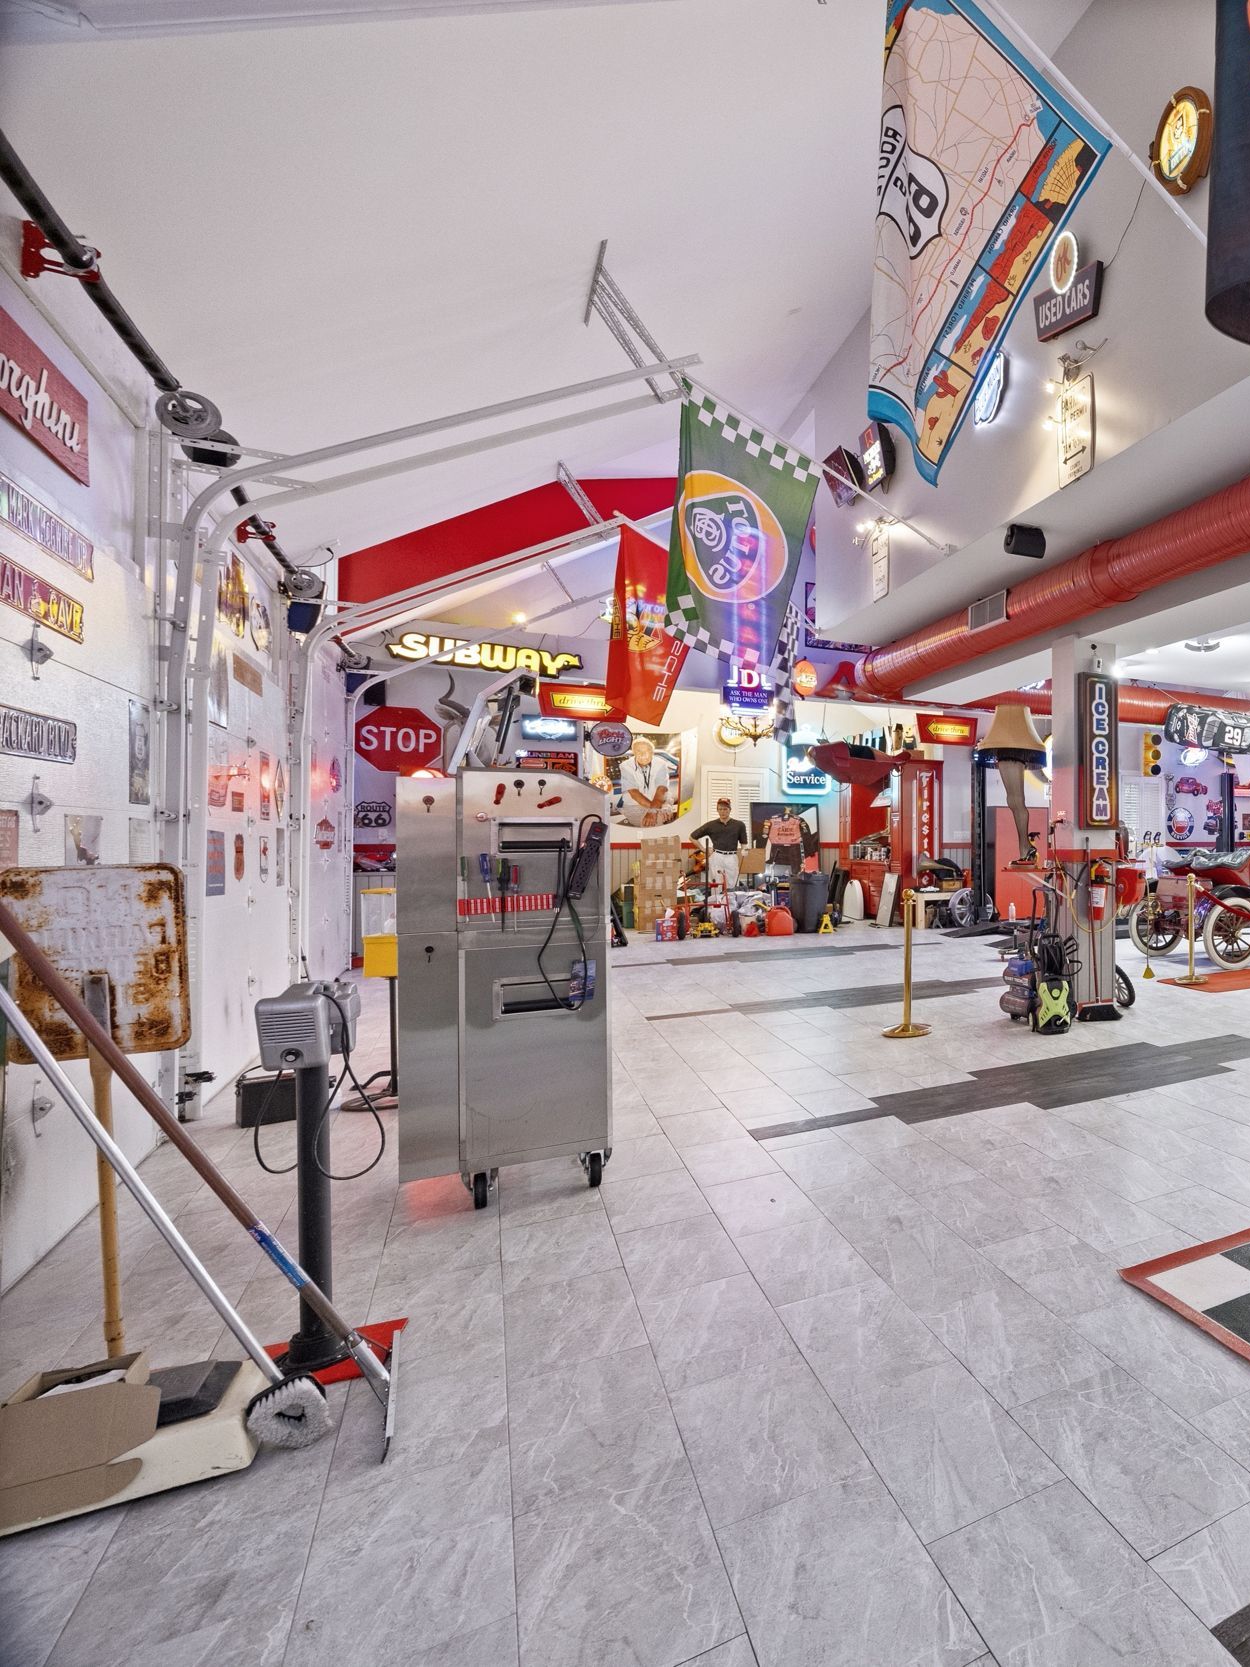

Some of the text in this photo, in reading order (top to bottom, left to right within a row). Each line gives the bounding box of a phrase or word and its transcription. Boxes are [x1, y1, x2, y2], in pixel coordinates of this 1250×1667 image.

[1039, 279, 1090, 329] USED CARS
[8, 483, 34, 539] MARK
[389, 632, 583, 678] SUBWAY
[359, 725, 437, 752] STOP
[1224, 726, 1242, 746] 29
[527, 751, 575, 759] UNBEAM
[1091, 683, 1111, 820] ICE CREAM
[786, 771, 827, 786] Service
[360, 804, 388, 812] ROUTE
[361, 813, 390, 826] 66
[919, 771, 932, 885] Fireste
[1171, 831, 1191, 841] SERVICE
